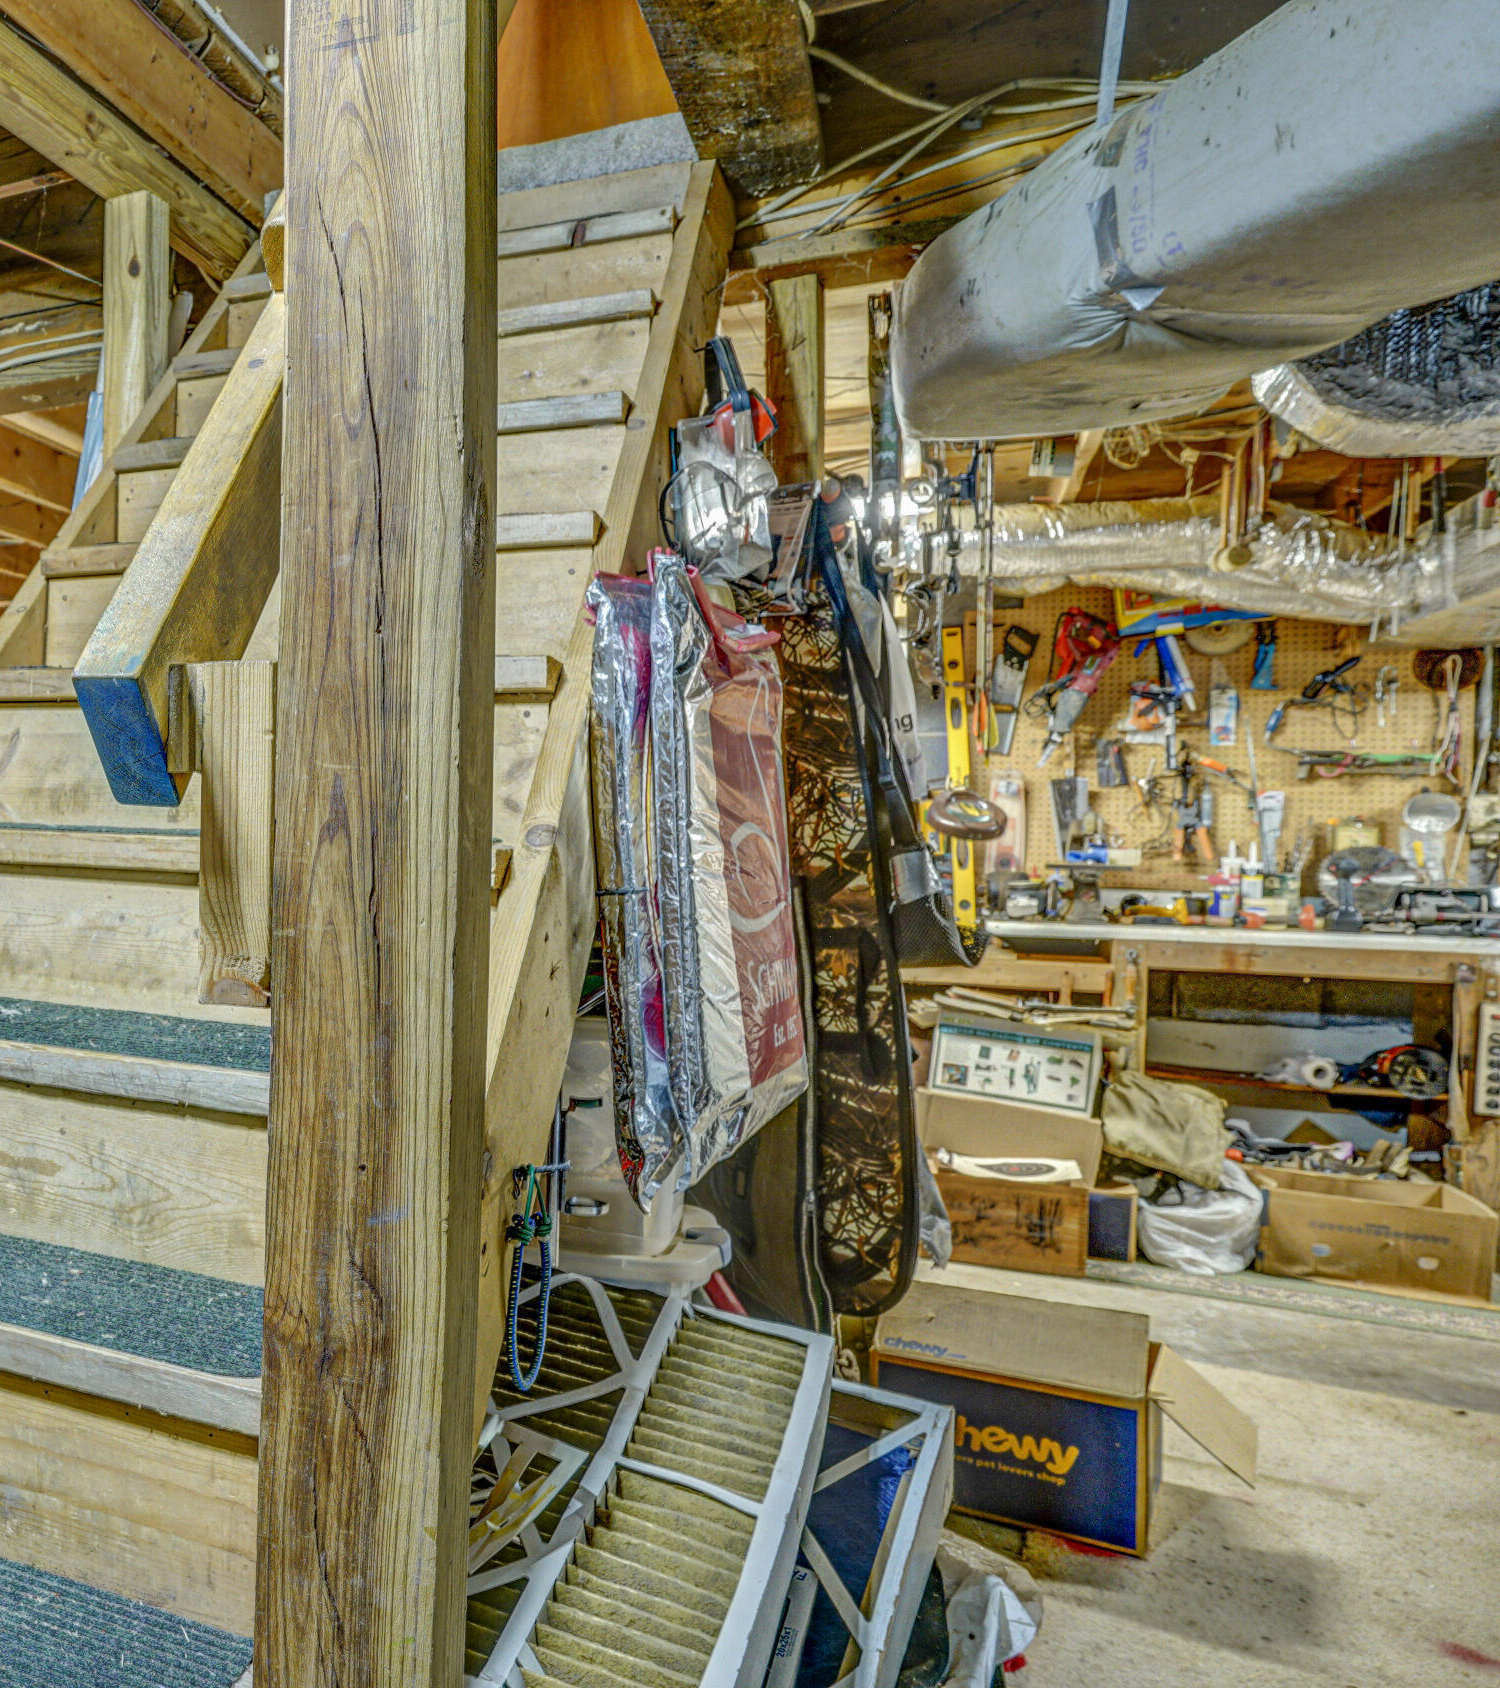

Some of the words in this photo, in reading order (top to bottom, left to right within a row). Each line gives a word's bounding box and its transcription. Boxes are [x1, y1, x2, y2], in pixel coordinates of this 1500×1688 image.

[895, 713, 914, 734] ng
[956, 1415, 1079, 1475] hewy
[976, 1457, 995, 1469] pet
[998, 1459, 1034, 1478] lovers
[1037, 1472, 1066, 1487] shop
